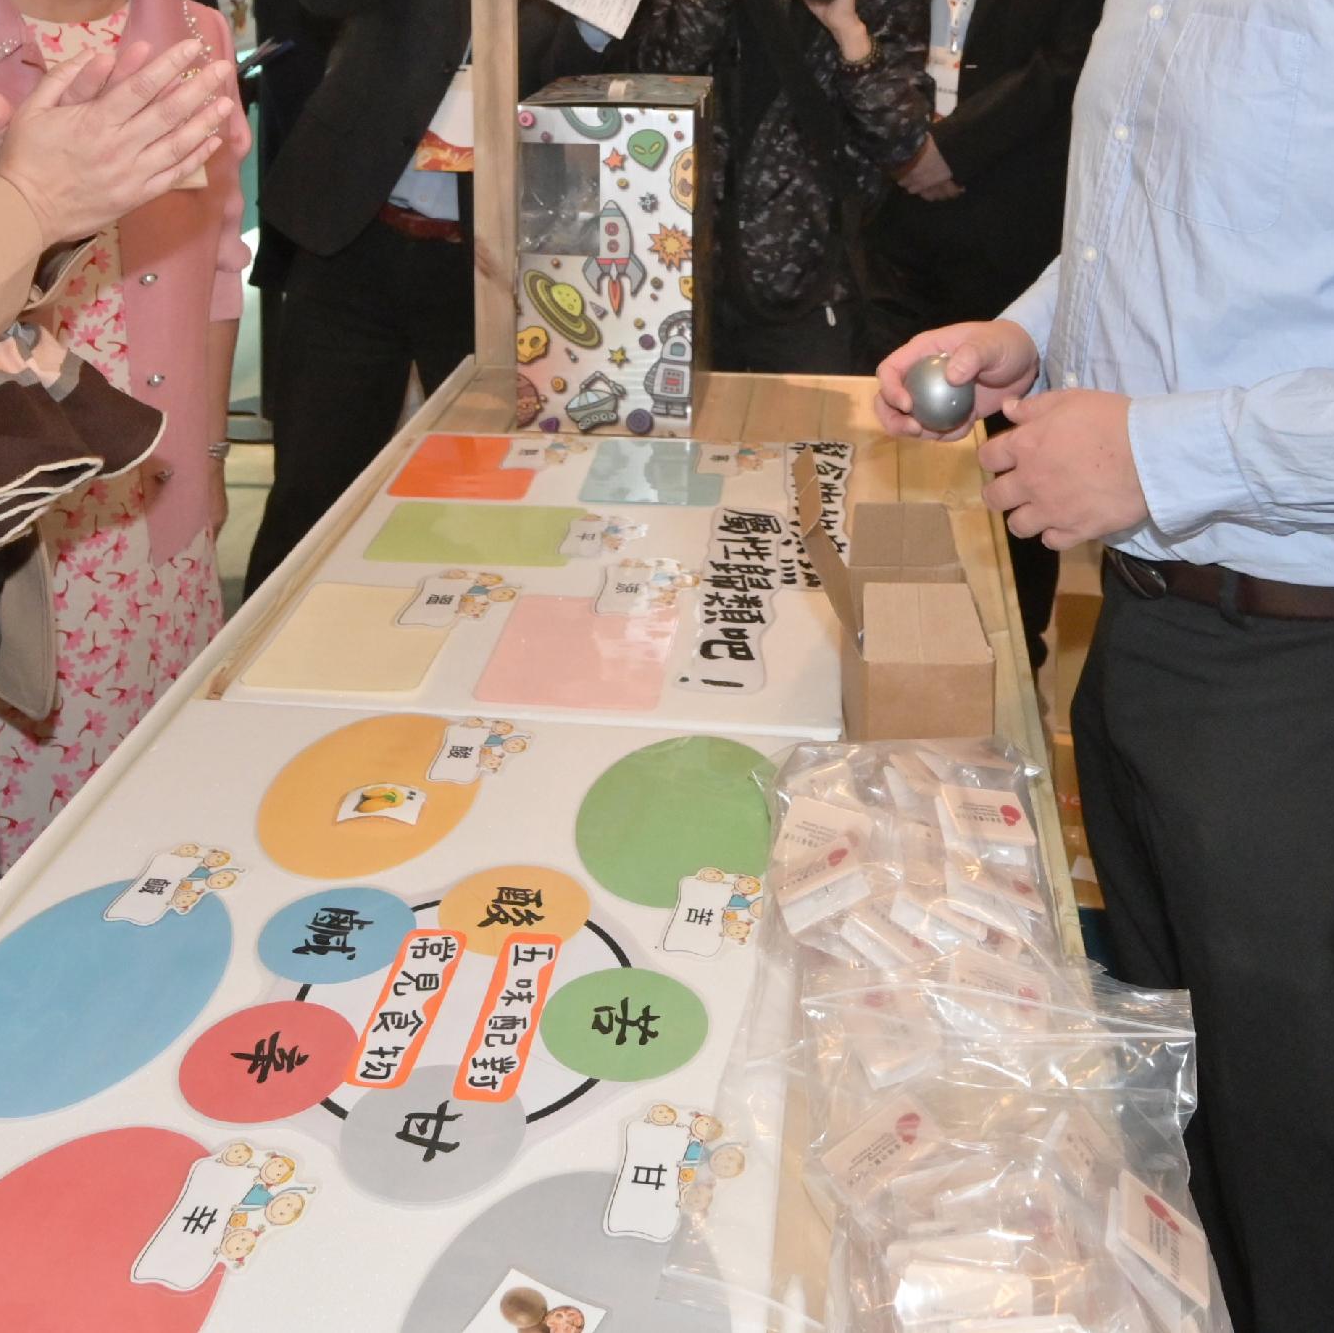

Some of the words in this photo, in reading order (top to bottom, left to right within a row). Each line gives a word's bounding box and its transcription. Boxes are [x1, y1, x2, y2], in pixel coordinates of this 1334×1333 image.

[448, 746, 473, 758] 酸
[138, 878, 171, 896] 鹹
[477, 887, 544, 927] 酸
[292, 908, 374, 960] 鹹
[684, 905, 714, 927] 苦
[359, 937, 459, 1082] 常見食物
[467, 942, 555, 1091] 五味配對
[592, 997, 660, 1045] 苦
[231, 1032, 309, 1083] 辛
[395, 1100, 462, 1162] 甘
[632, 1164, 667, 1190] 甘
[181, 1203, 218, 1236] 辛
